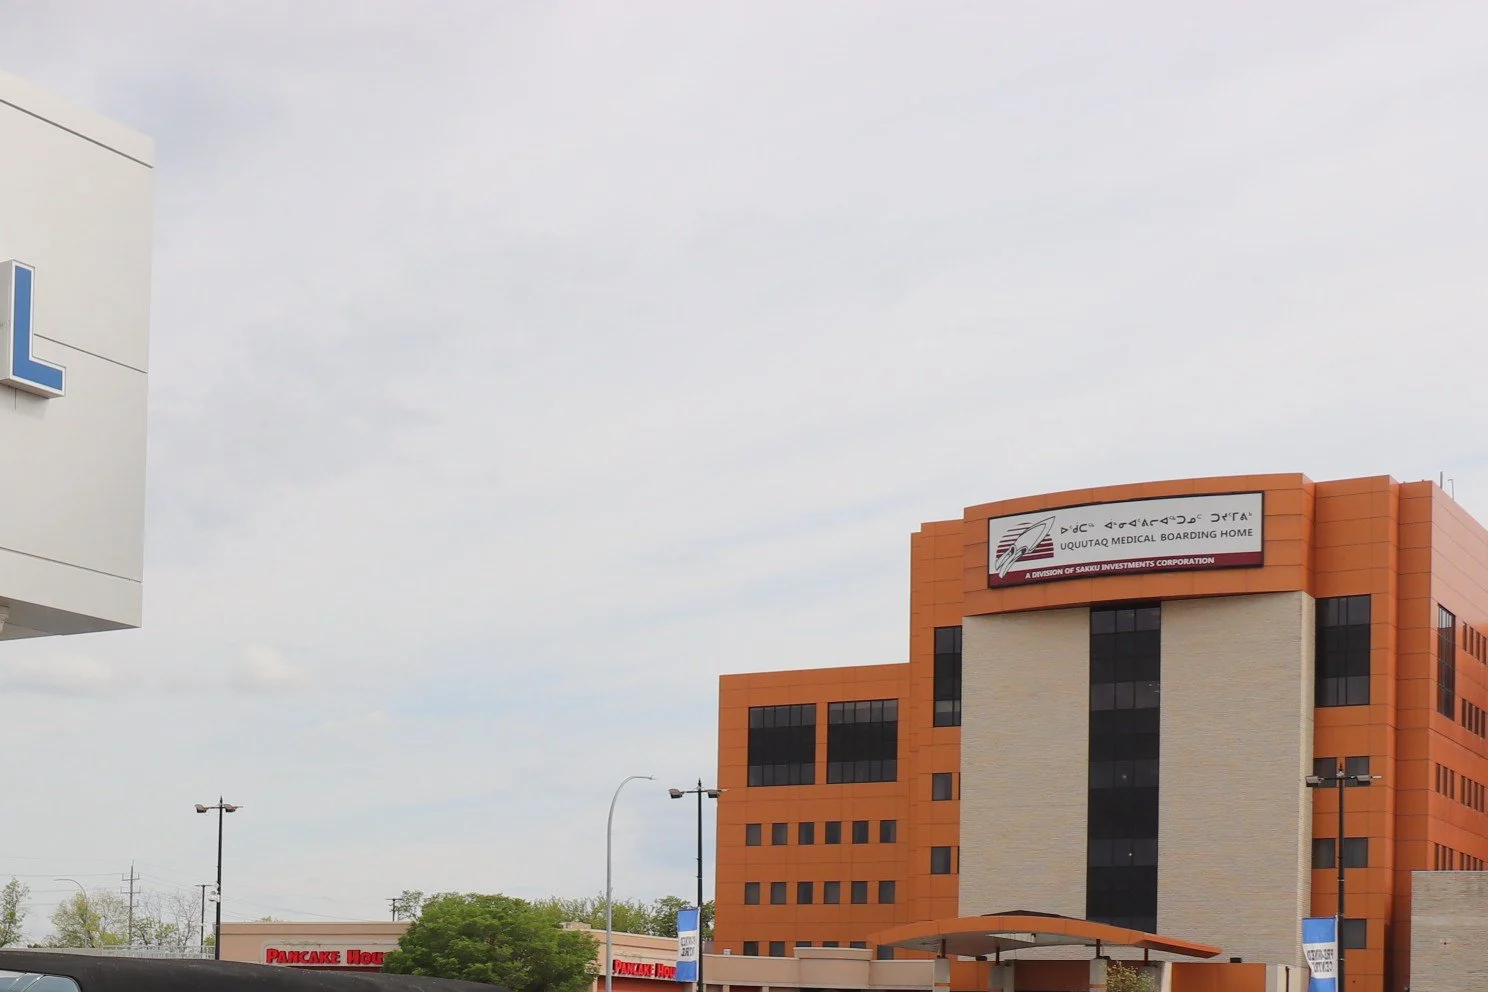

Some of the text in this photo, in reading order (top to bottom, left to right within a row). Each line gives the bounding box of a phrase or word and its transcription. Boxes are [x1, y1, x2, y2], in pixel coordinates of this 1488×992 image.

[1060, 528, 1254, 551] UQUUTAQ MEDICAL BOARDING HOME
[1032, 569, 1062, 578] DIVISION
[1064, 567, 1075, 575] OF
[1076, 564, 1100, 574] SAKKU
[1101, 560, 1155, 571] INVESTMENTS
[1156, 557, 1214, 568] CORPORATION
[266, 949, 388, 965] PANCAKE HOU
[613, 960, 676, 979] PANCAKE HOU
